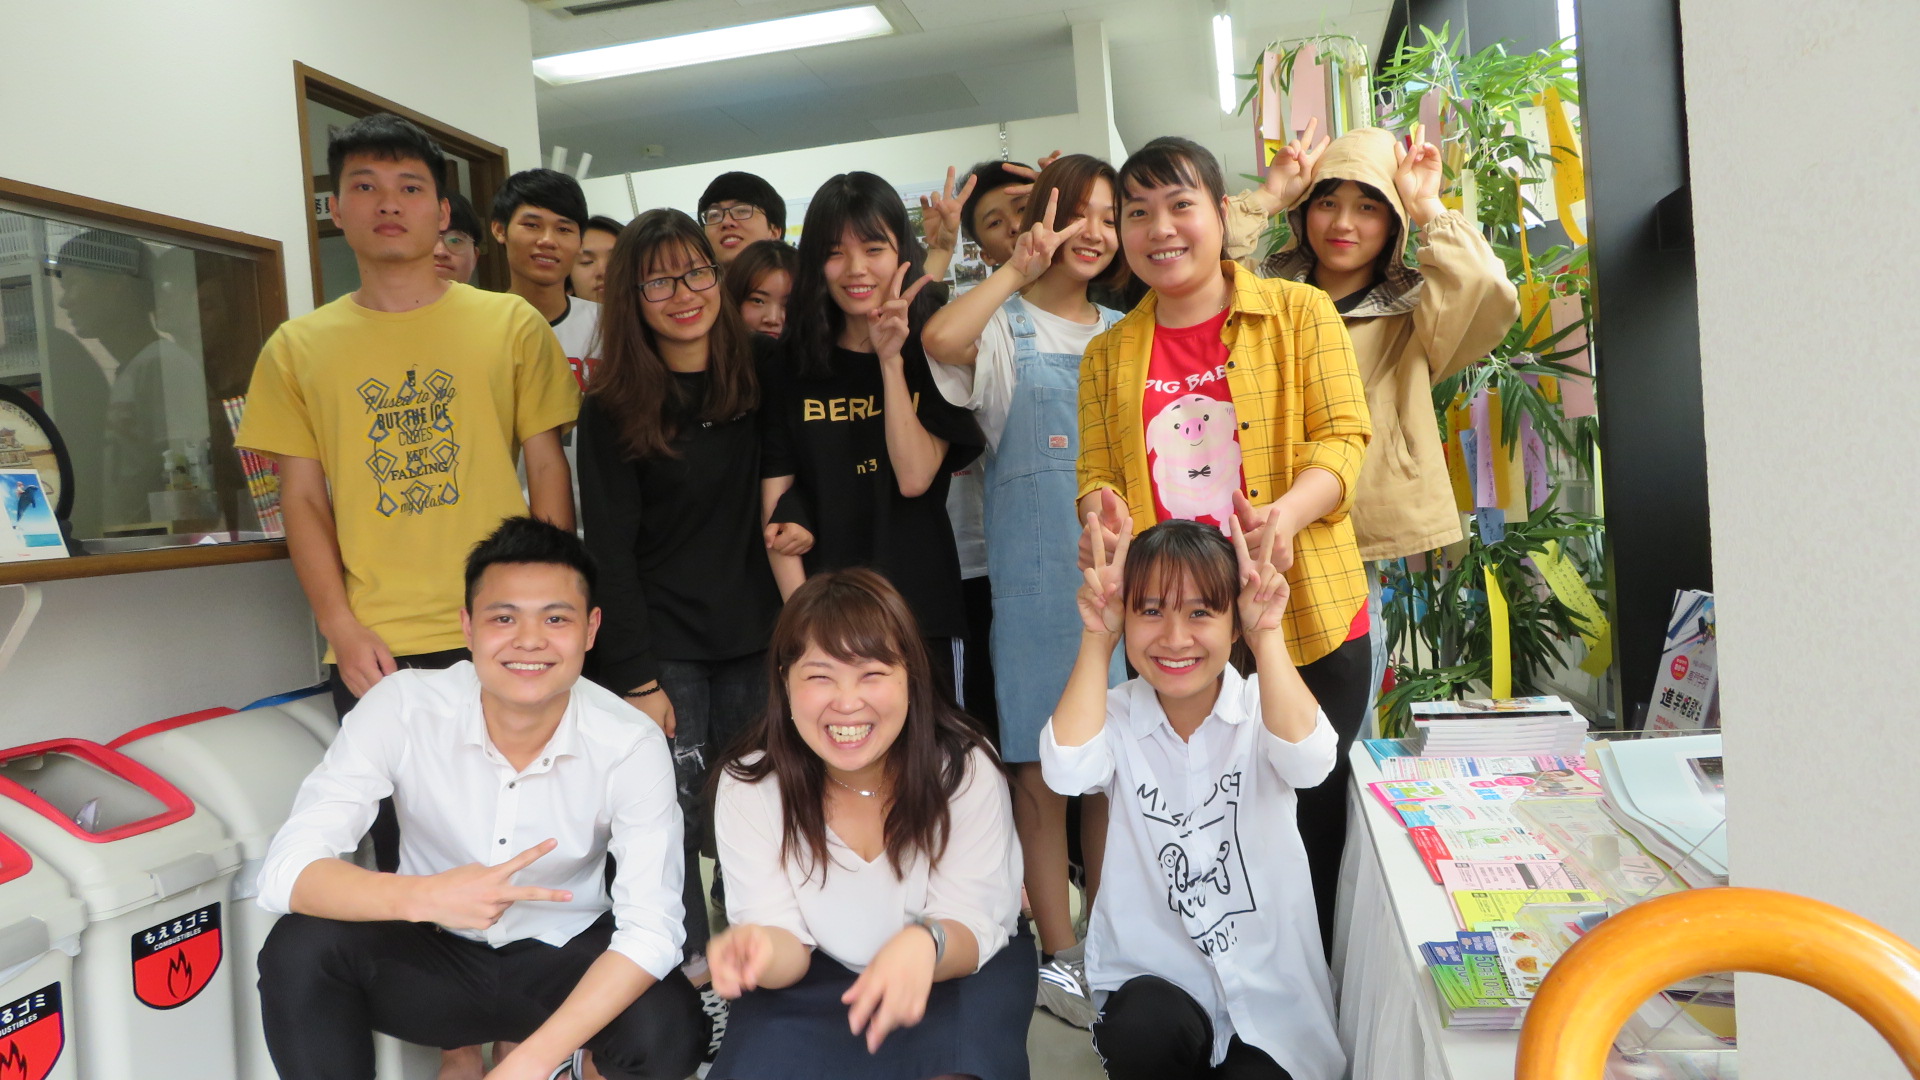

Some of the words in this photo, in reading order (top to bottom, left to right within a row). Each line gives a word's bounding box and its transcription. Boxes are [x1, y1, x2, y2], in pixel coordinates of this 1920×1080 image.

[416, 389, 430, 404] to
[377, 411, 400, 430] BUT
[404, 407, 427, 426] THE
[431, 402, 449, 421] ICE
[398, 427, 433, 446] CUBES
[406, 447, 429, 462] KEPT
[390, 461, 448, 480] FALLING
[144, 911, 208, 944] もえるゴミ
[154, 927, 201, 951] COMBUSTIBLES
